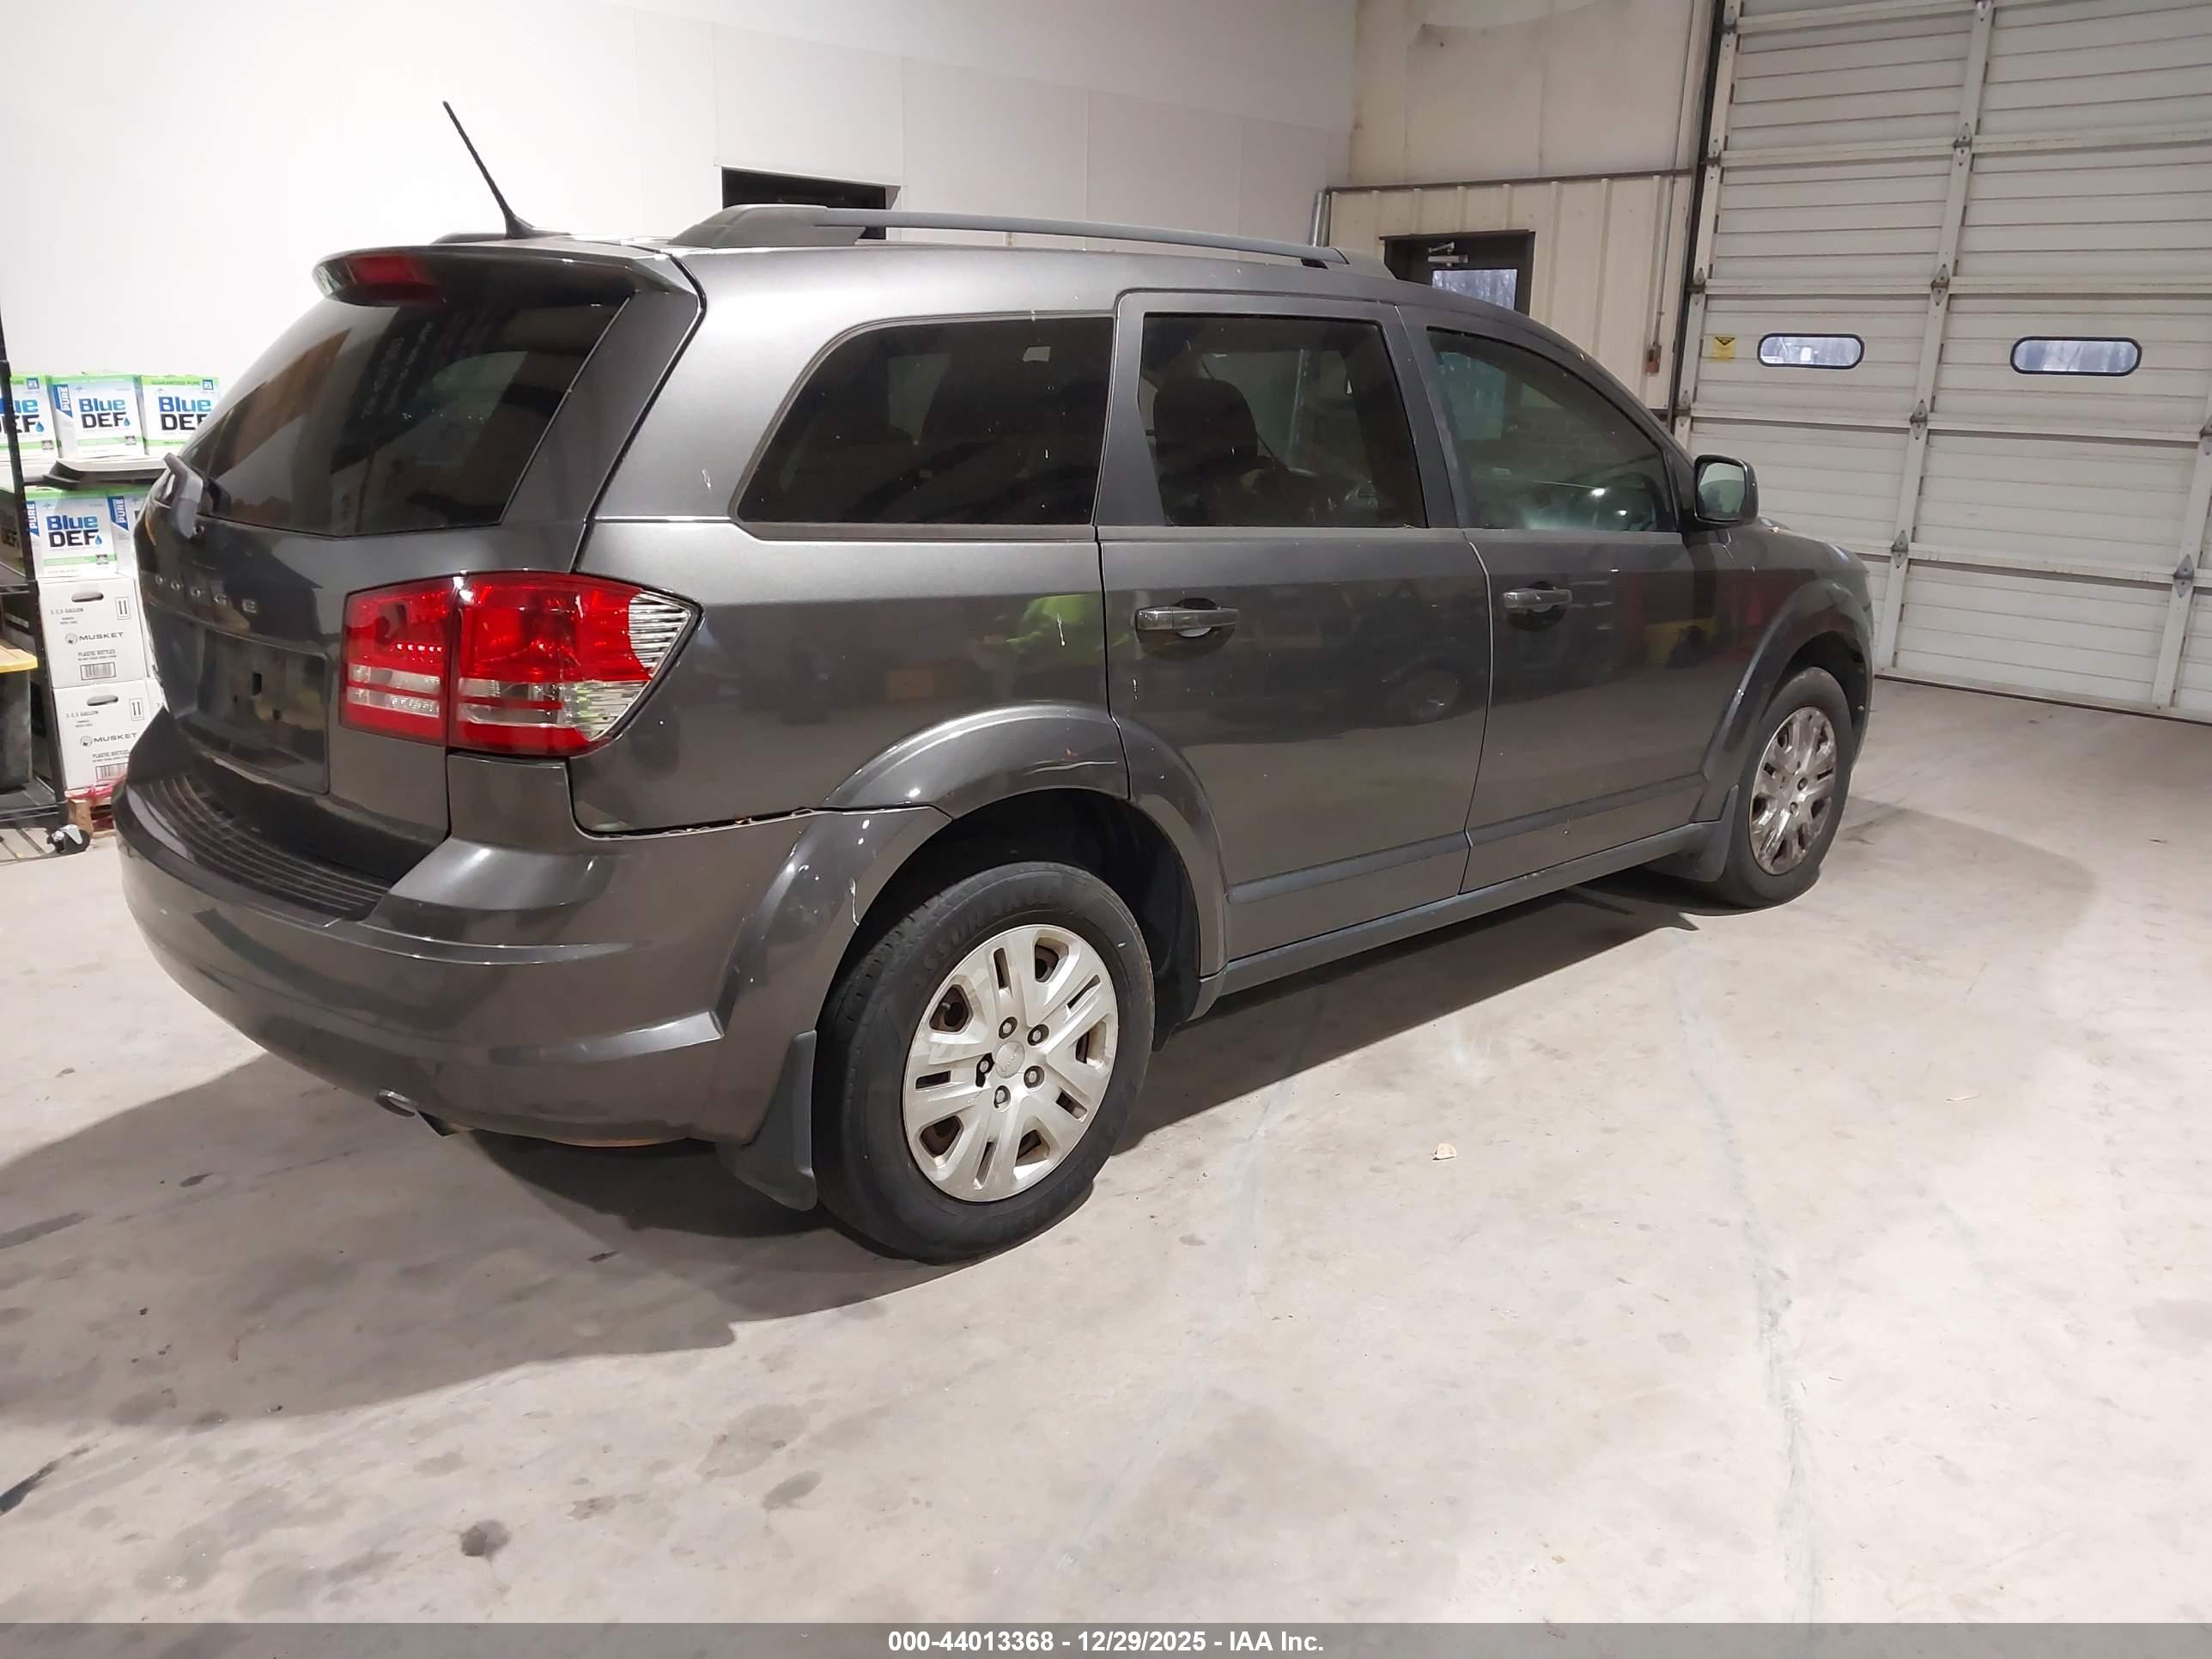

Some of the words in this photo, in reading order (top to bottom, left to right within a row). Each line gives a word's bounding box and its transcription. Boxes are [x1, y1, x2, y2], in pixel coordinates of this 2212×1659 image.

[61, 386, 70, 410] PURE
[78, 398, 126, 412] Blue
[158, 396, 211, 412] Blue
[81, 412, 127, 428] DEF
[27, 503, 37, 530] PURE
[116, 498, 126, 524] PURE
[46, 515, 99, 531] Blue
[48, 529, 99, 548] DEF
[79, 632, 125, 641] MUSKET
[94, 732, 137, 743] MUSKET
